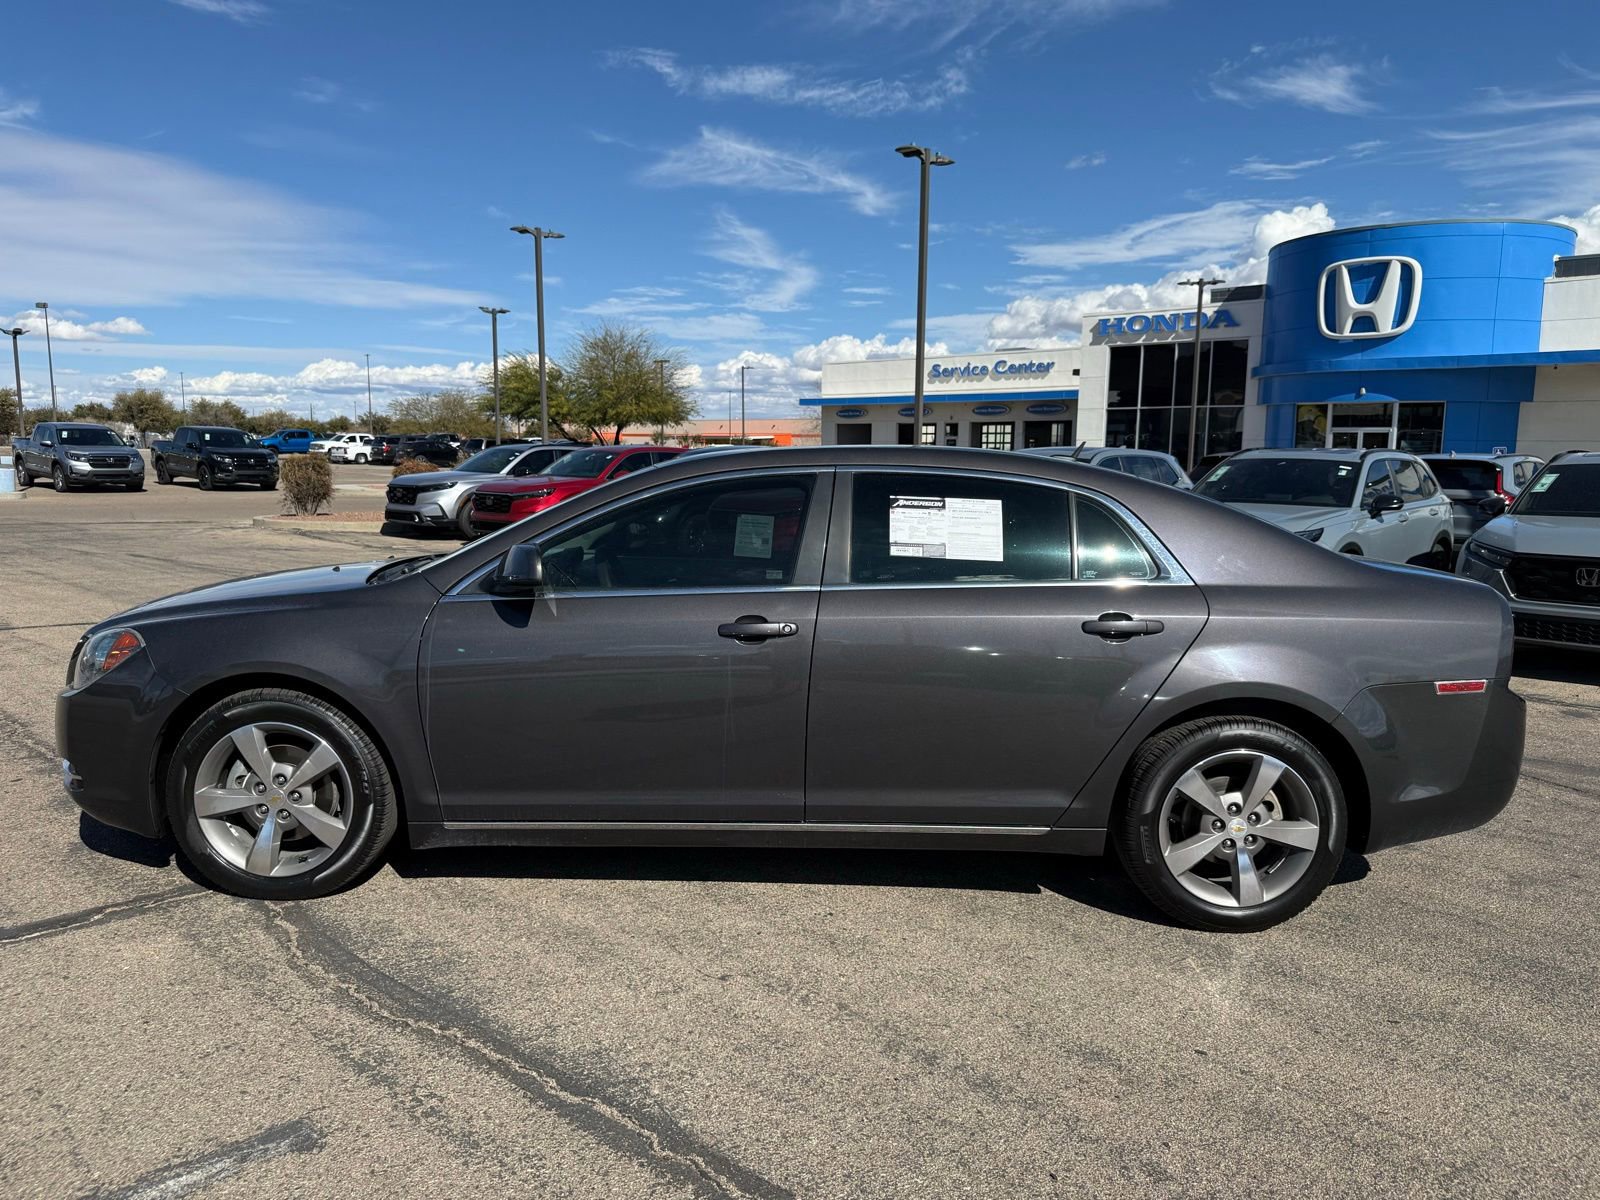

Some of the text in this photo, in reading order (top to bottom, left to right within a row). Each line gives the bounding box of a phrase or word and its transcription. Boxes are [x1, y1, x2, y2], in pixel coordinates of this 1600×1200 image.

[1098, 309, 1240, 337] HONDA
[931, 360, 1055, 378] Service Center
